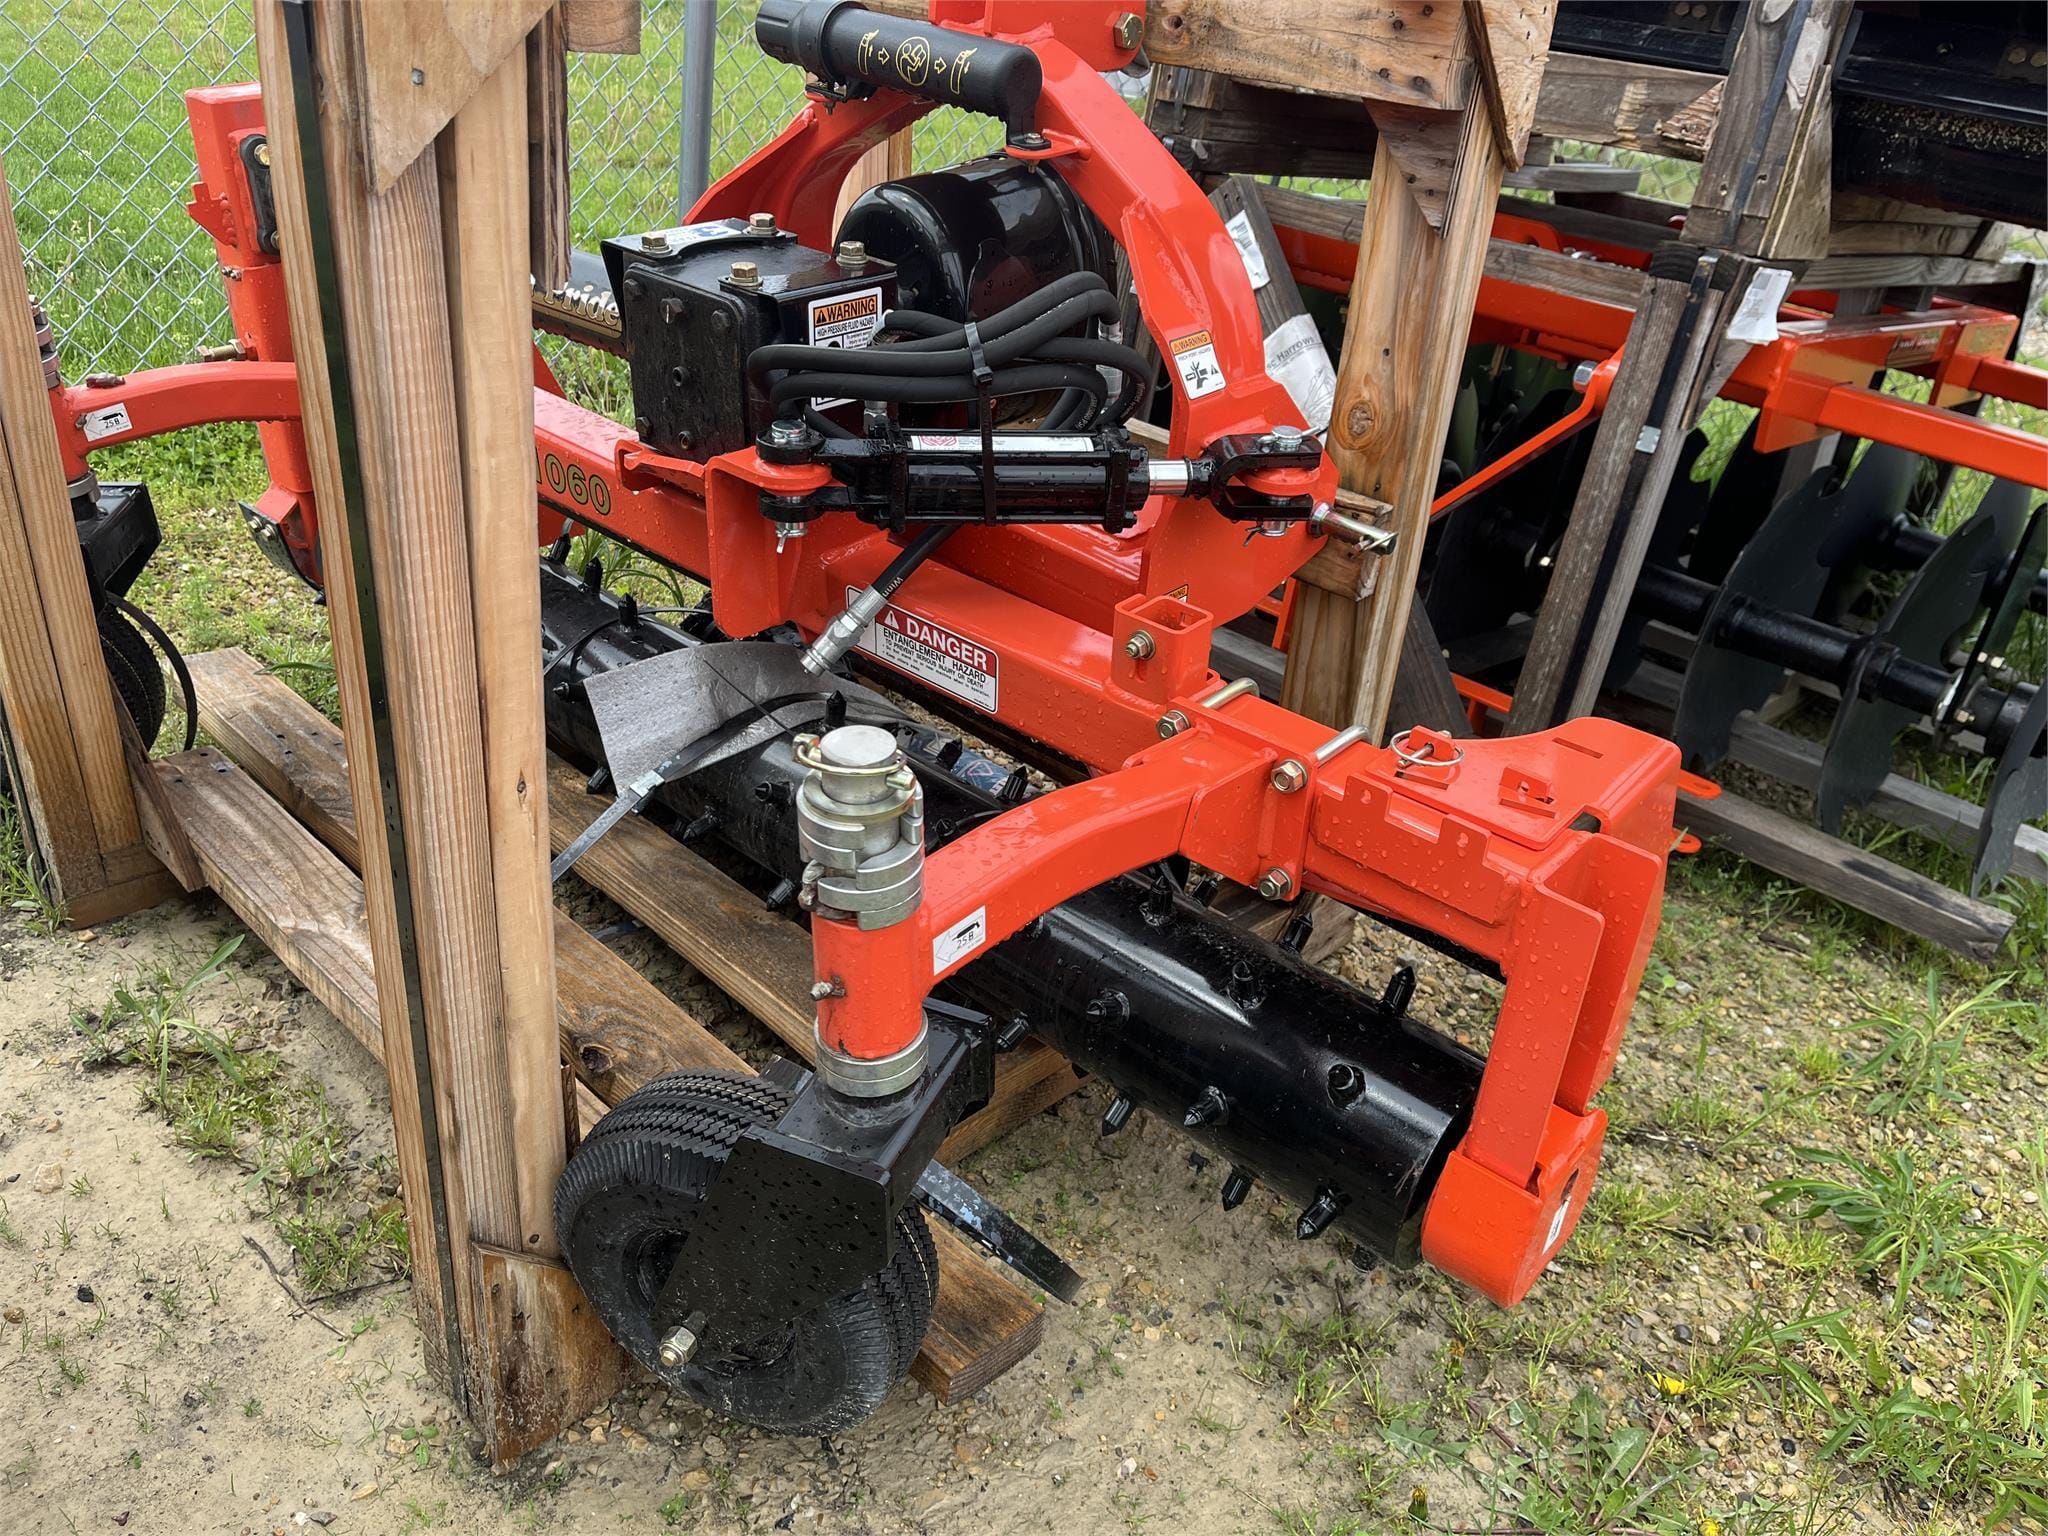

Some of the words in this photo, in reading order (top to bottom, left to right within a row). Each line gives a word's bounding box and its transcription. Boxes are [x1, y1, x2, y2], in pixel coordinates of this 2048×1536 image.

[827, 298, 875, 322] WARNING
[817, 327, 827, 337] HIGH
[827, 322, 848, 335] PRESSURE
[847, 320, 859, 331] FLUID
[860, 316, 875, 329] HAZARD
[1178, 333, 1208, 350] WARNING
[1276, 336, 1316, 362] Harrows
[883, 627, 946, 665] ENTANGLEMENT
[952, 659, 986, 684] HAZARD
[906, 617, 987, 672] DANGER
[893, 642, 915, 657] PREVENT
[916, 652, 937, 668] SERIOUS
[938, 661, 956, 677] INJURY
[966, 675, 984, 689] DEATH
